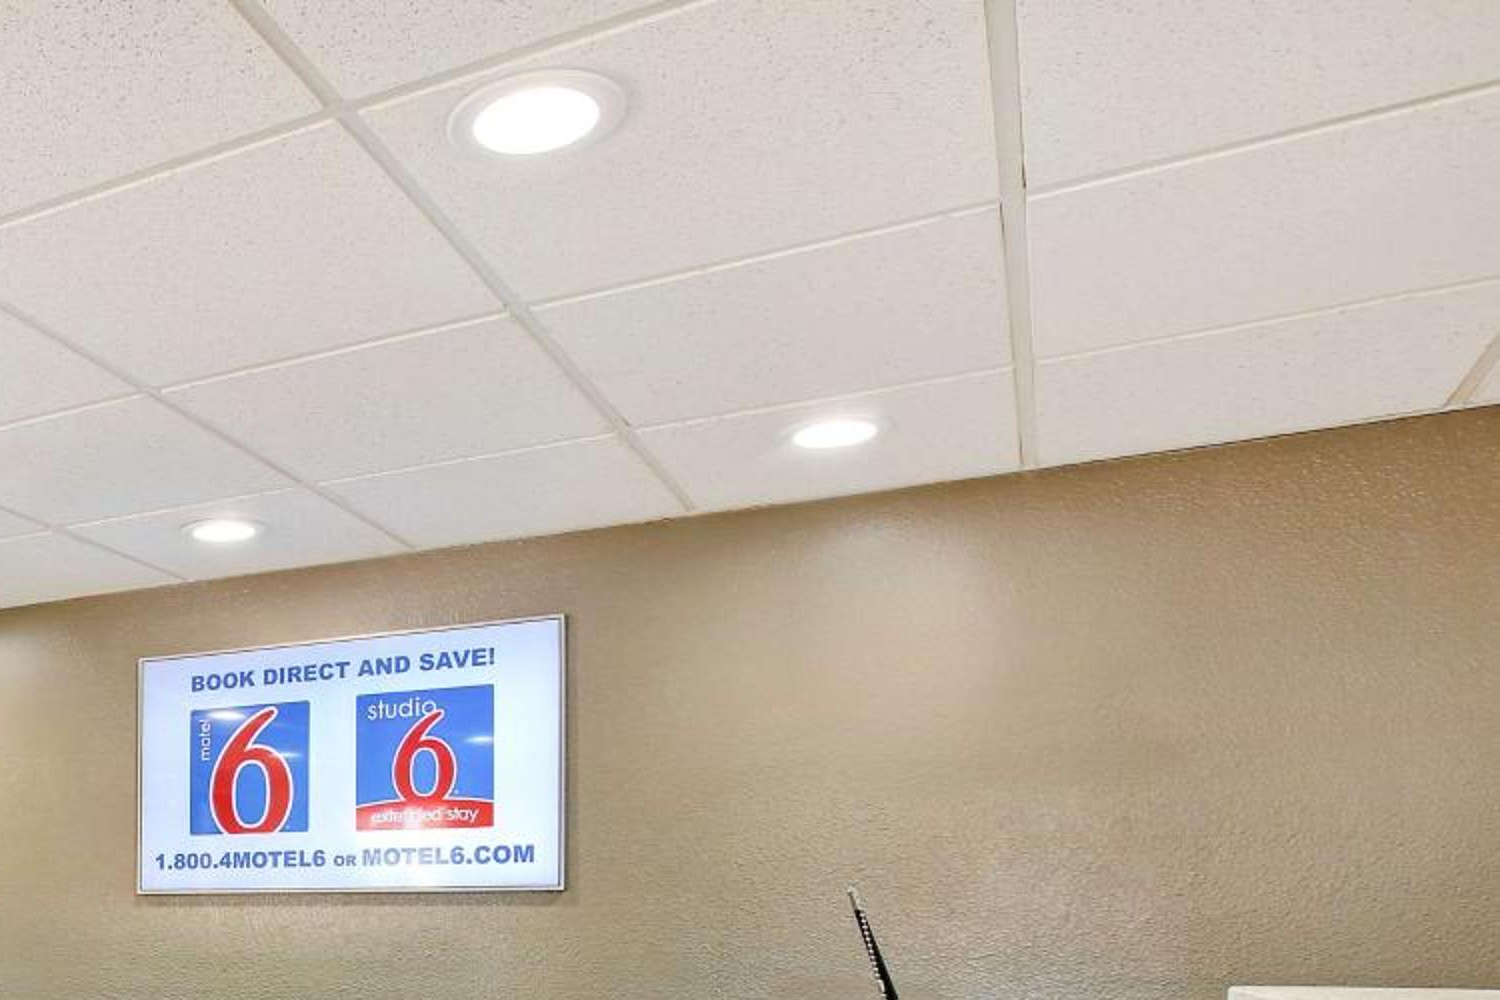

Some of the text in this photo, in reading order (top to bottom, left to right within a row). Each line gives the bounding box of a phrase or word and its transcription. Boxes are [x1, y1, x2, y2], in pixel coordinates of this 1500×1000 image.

[191, 647, 495, 692] BOOK DIRECT AND SAVE!
[199, 706, 294, 834] motel 6
[367, 697, 457, 802] studio 6
[372, 806, 480, 824] exteed stay
[155, 844, 535, 870] 1.800.4MOTEL6 OR MOTEL6.COM
